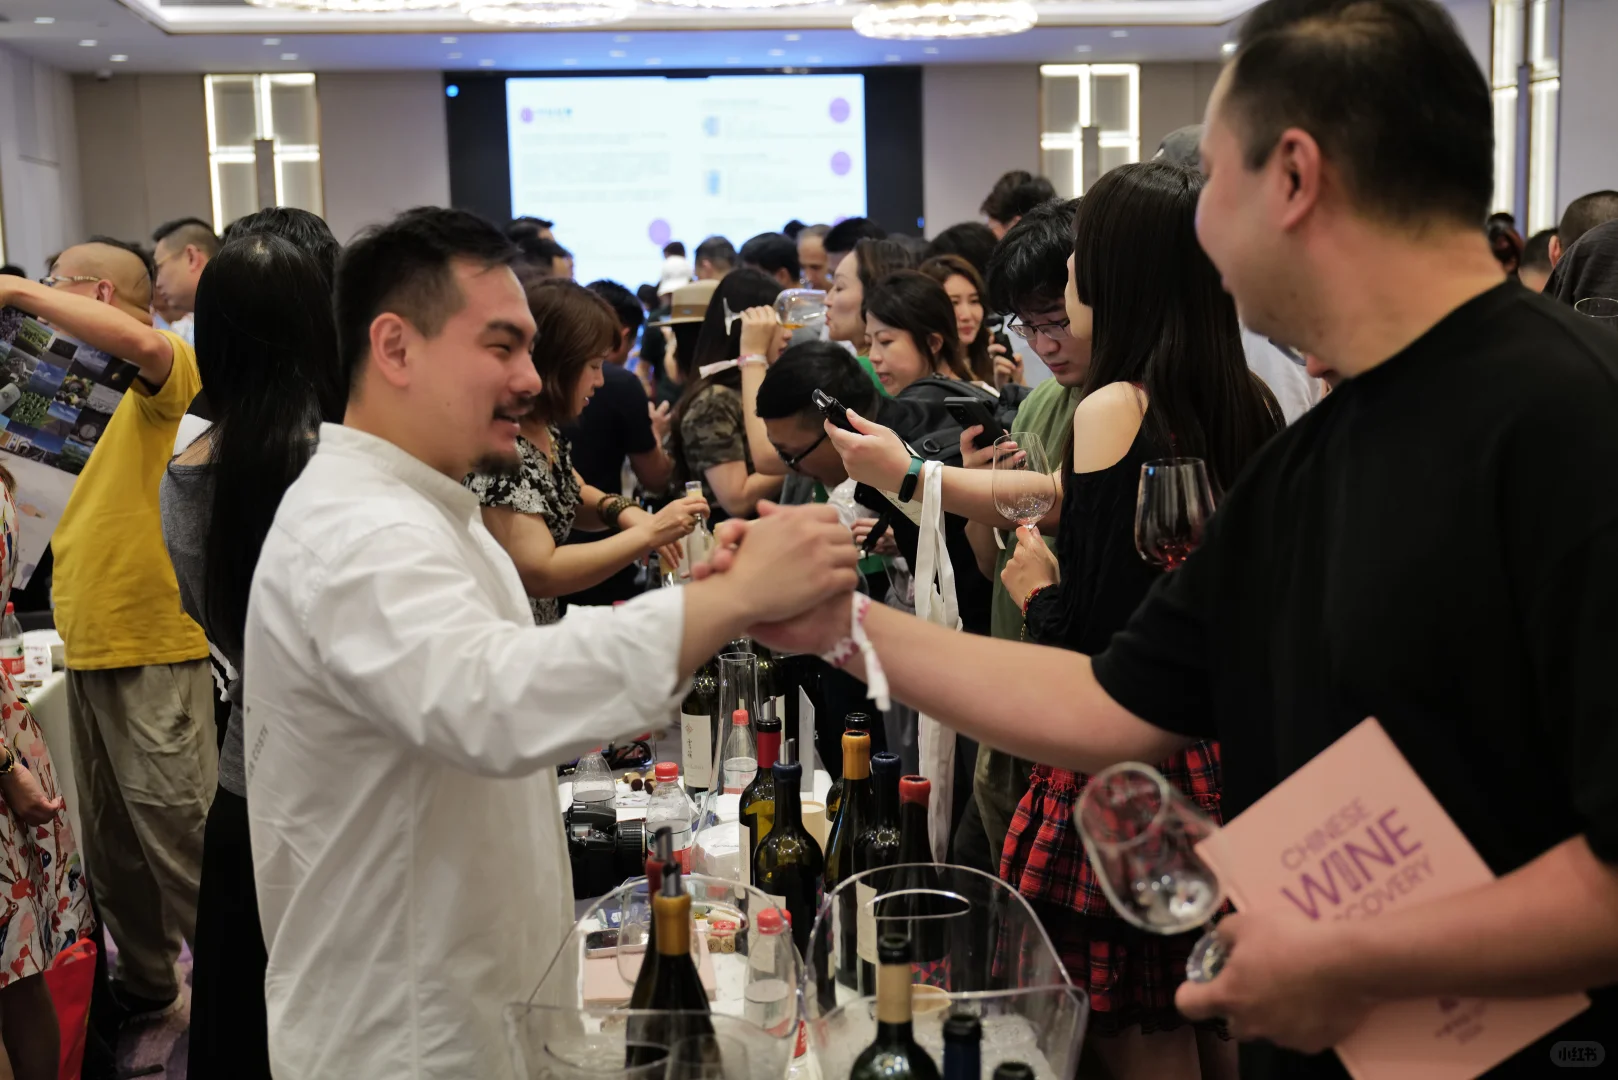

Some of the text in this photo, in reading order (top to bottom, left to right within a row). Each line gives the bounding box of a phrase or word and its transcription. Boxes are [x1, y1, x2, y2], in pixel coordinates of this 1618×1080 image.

[1280, 798, 1371, 871] CHINESE
[1281, 808, 1423, 921] WINE
[1333, 852, 1435, 922] COVERY
